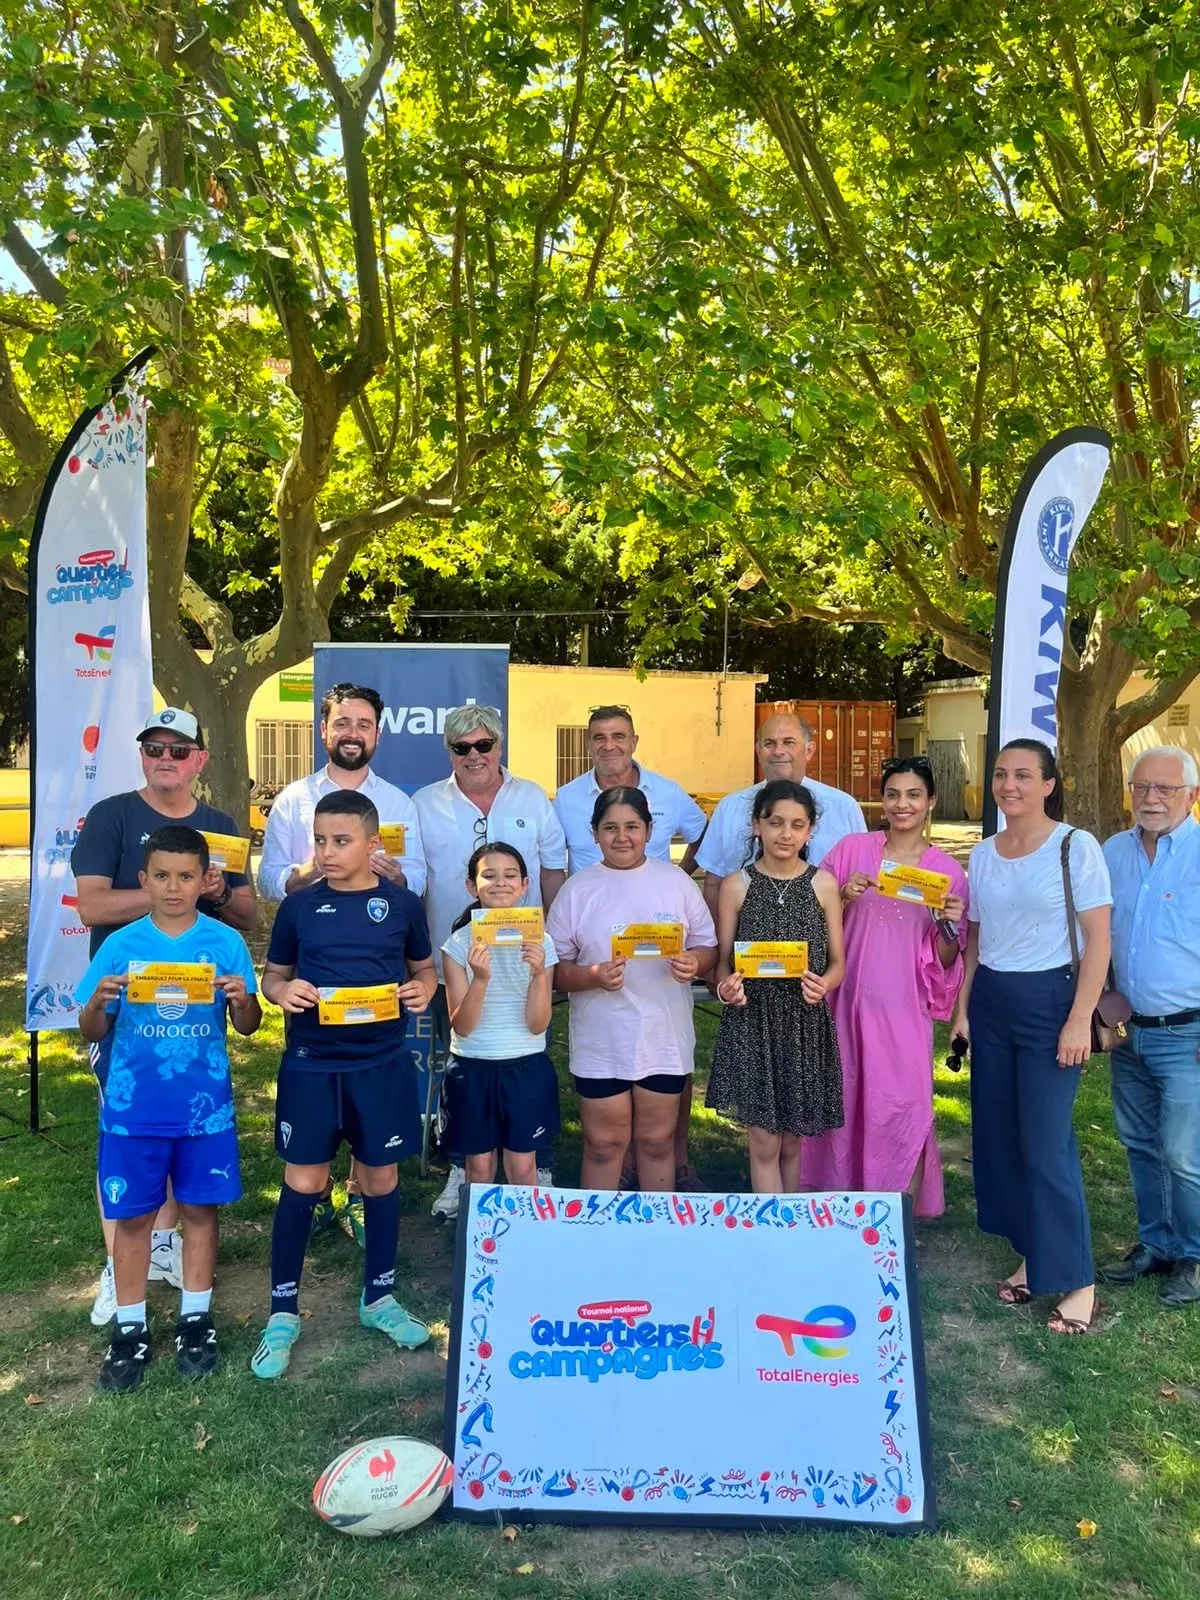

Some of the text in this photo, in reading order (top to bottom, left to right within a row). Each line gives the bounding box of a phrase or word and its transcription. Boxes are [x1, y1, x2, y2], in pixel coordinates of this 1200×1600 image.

[134, 1023, 210, 1038] MOROCCO
[581, 1304, 649, 1316] Tournoi national
[756, 1368, 860, 1387] TotalEnergies
[370, 1484, 399, 1494] FRANCE
[371, 1490, 399, 1501] RUGBY
